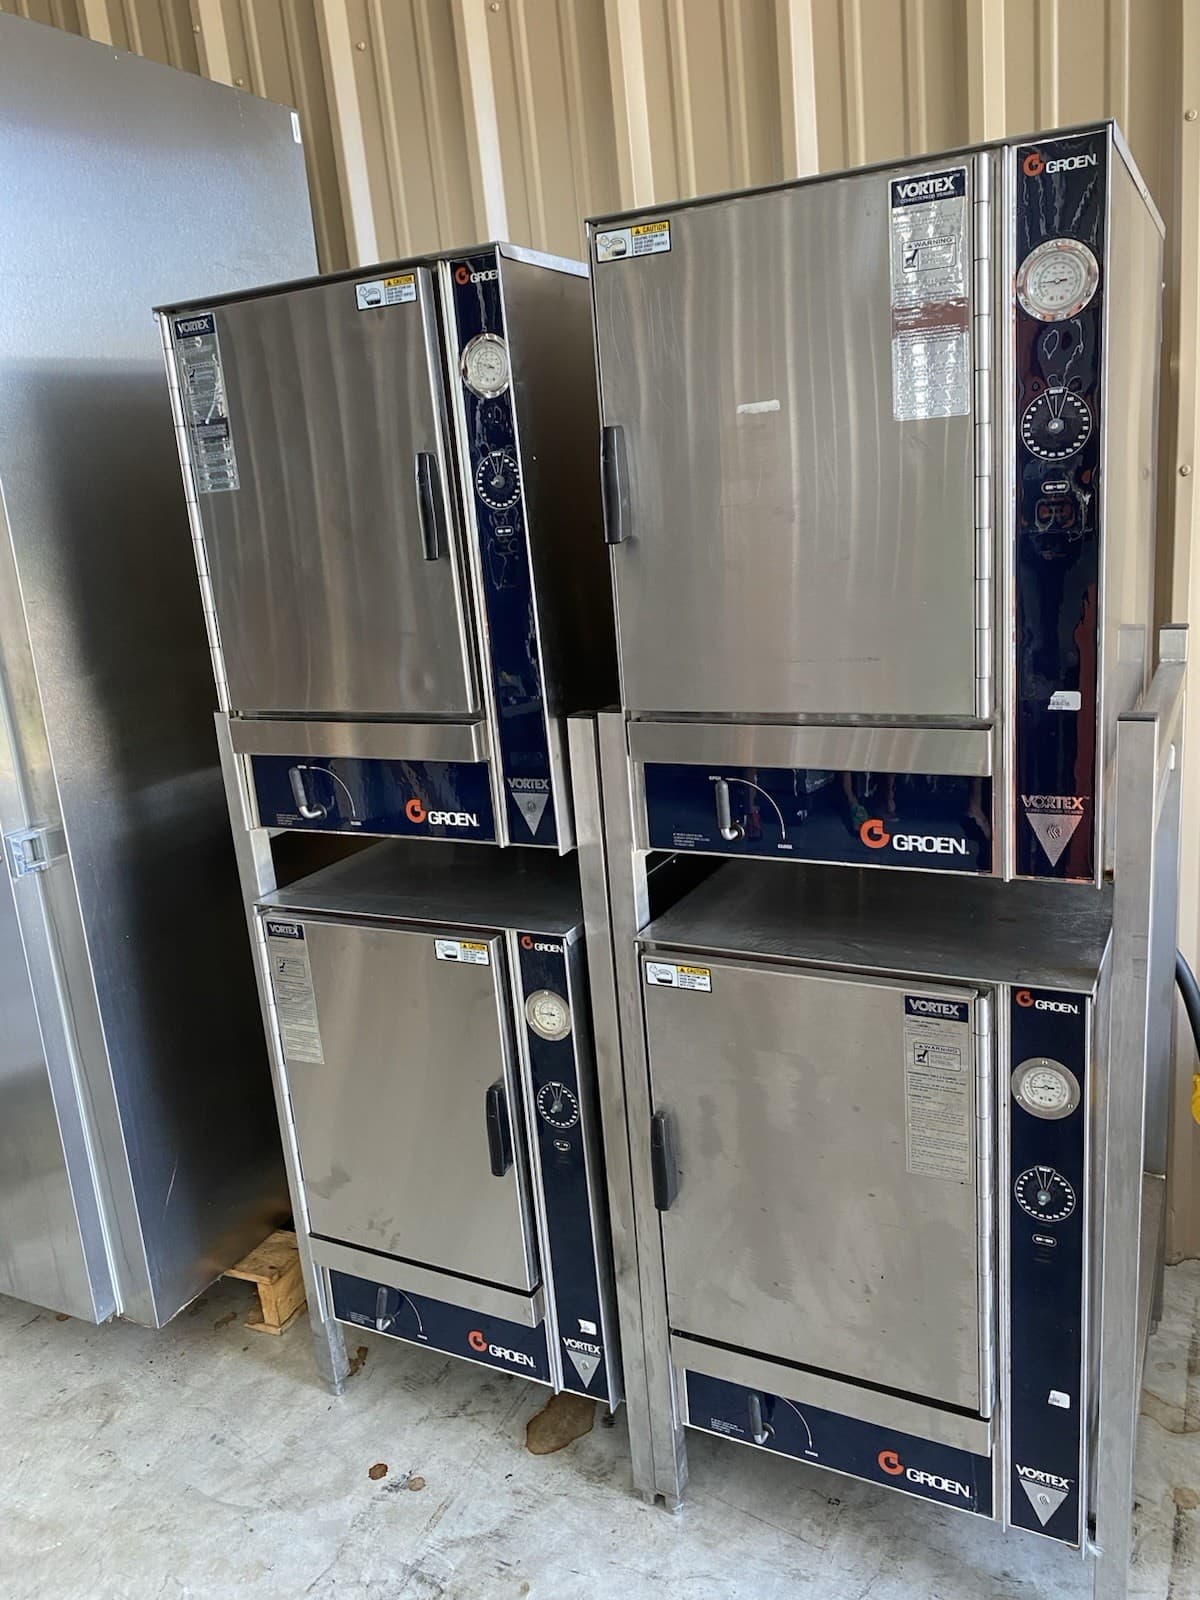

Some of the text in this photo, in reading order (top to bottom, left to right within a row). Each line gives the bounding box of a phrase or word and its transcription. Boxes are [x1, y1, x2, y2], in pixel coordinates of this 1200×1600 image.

[1046, 154, 1098, 174] GROEN
[896, 175, 956, 199] VORTEX
[470, 269, 499, 284] GROE
[177, 318, 210, 334] VORTEX
[507, 777, 550, 791] VORTEX
[1020, 794, 1084, 811] VORTEX
[427, 811, 479, 828] GROEN
[892, 834, 968, 855] GROEN
[534, 942, 564, 953] GROEN
[909, 998, 960, 1016] VORTEX
[1034, 999, 1079, 1015] GROEN
[562, 1336, 602, 1355] VORTEX
[488, 1344, 536, 1368] GROEN
[905, 1467, 971, 1499] GROEN
[1015, 1463, 1070, 1490] VORTEX
